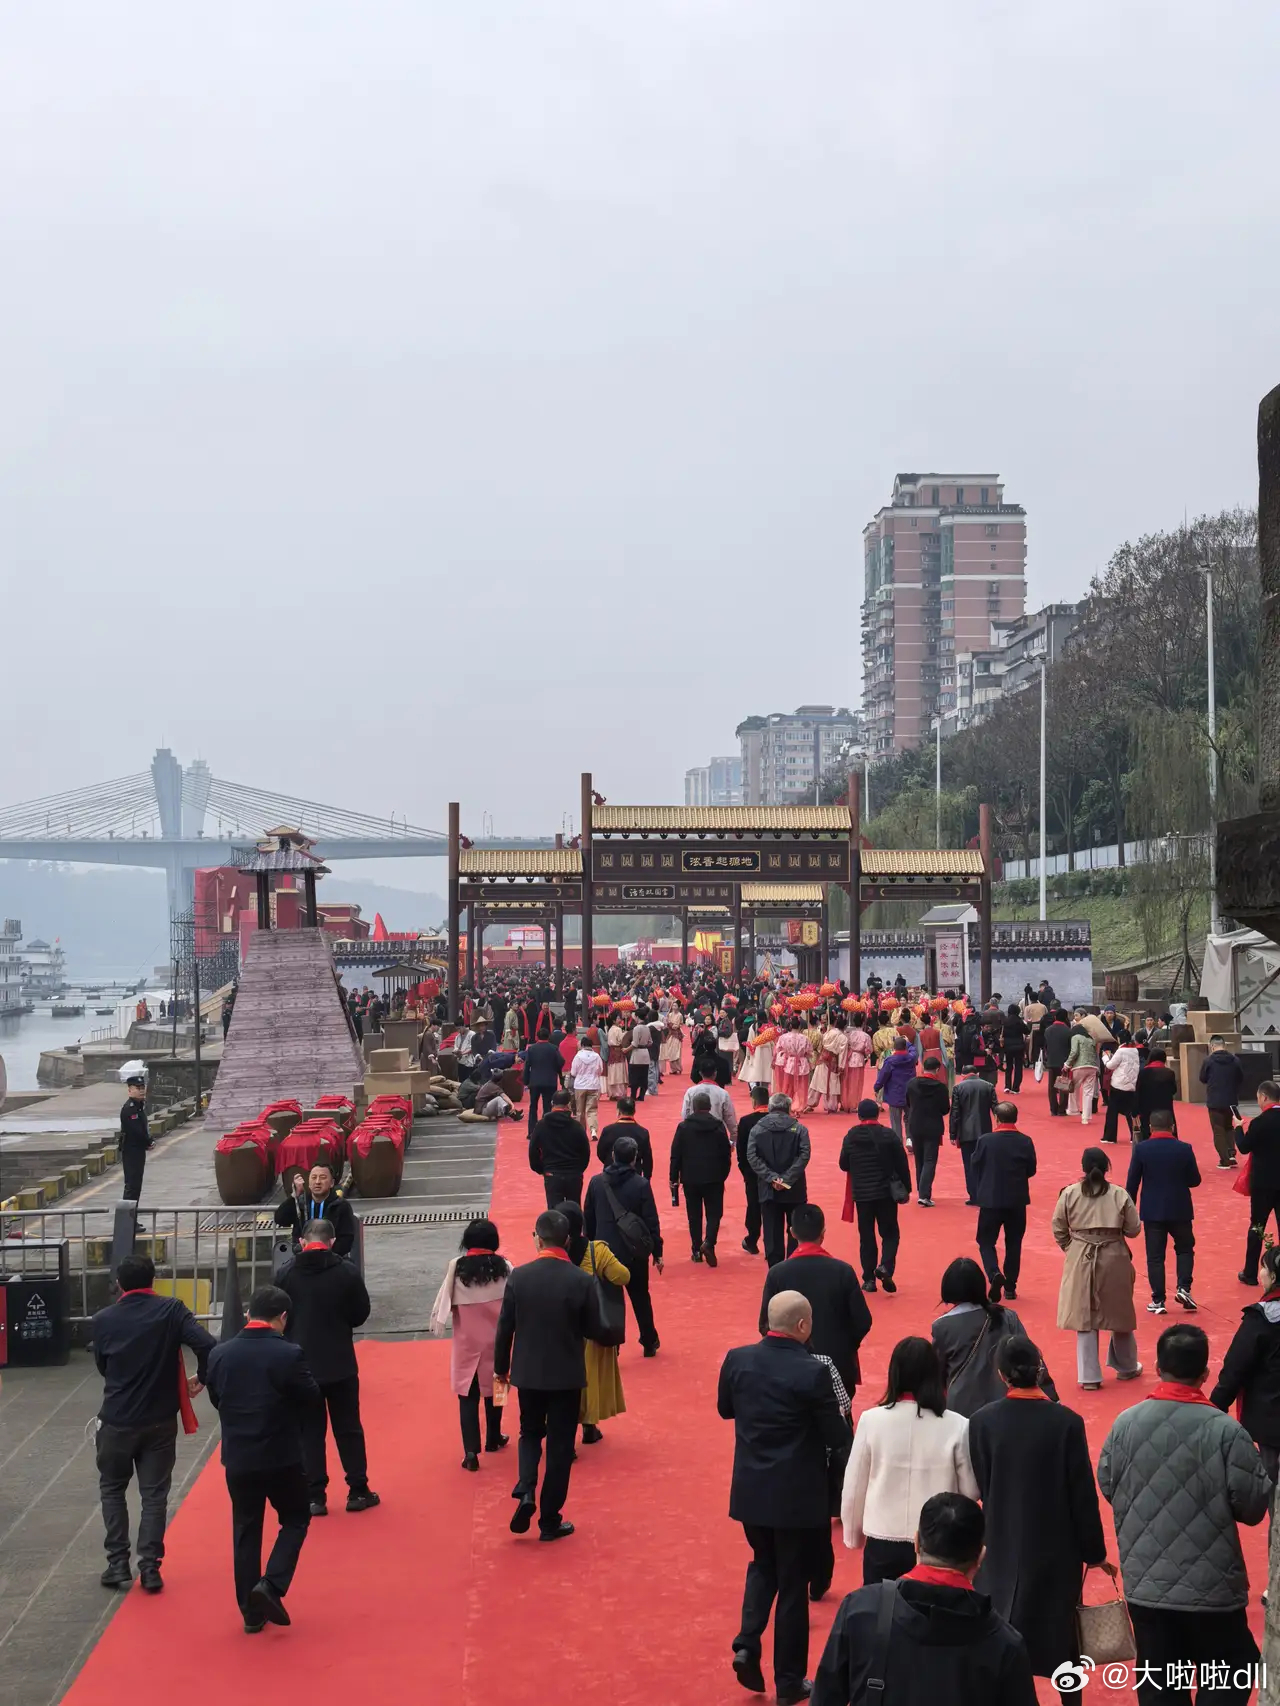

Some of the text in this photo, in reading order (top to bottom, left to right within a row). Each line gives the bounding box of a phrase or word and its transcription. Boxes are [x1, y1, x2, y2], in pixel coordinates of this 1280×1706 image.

[689, 856, 753, 867] 浓香起源地
